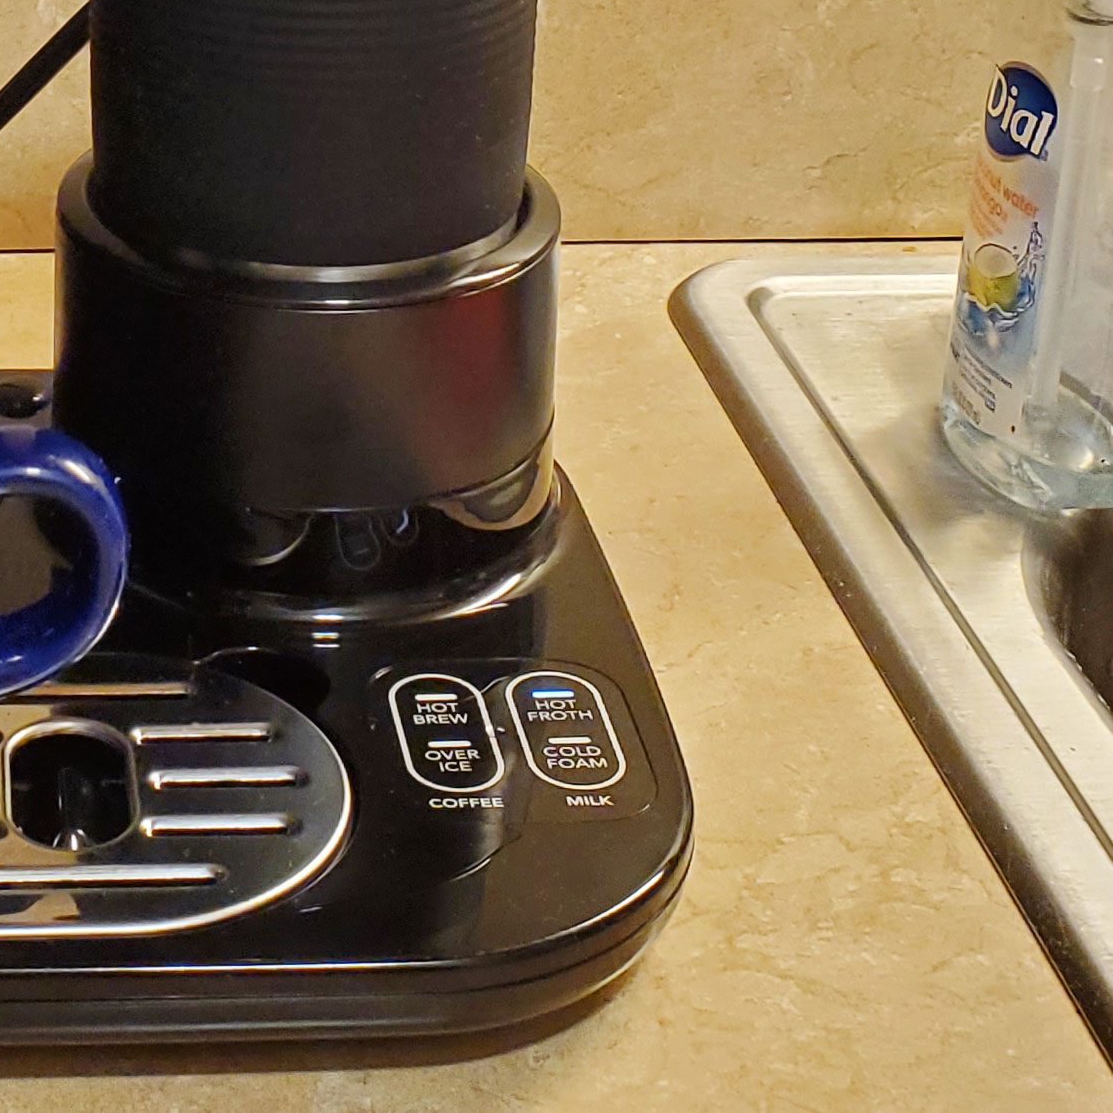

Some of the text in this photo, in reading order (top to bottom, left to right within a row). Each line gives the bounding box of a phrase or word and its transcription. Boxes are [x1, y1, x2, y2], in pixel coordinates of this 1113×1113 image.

[988, 65, 1055, 156] Dial
[416, 702, 458, 714] HOT
[535, 699, 576, 711] HOT
[412, 713, 468, 725] BREW
[527, 710, 594, 722] FROTH
[424, 749, 481, 761] OVER
[543, 746, 601, 758] COLD
[438, 761, 473, 773] ICE
[546, 757, 608, 770] FOAM
[428, 797, 505, 809] COFFEE
[566, 795, 615, 807] MILK
